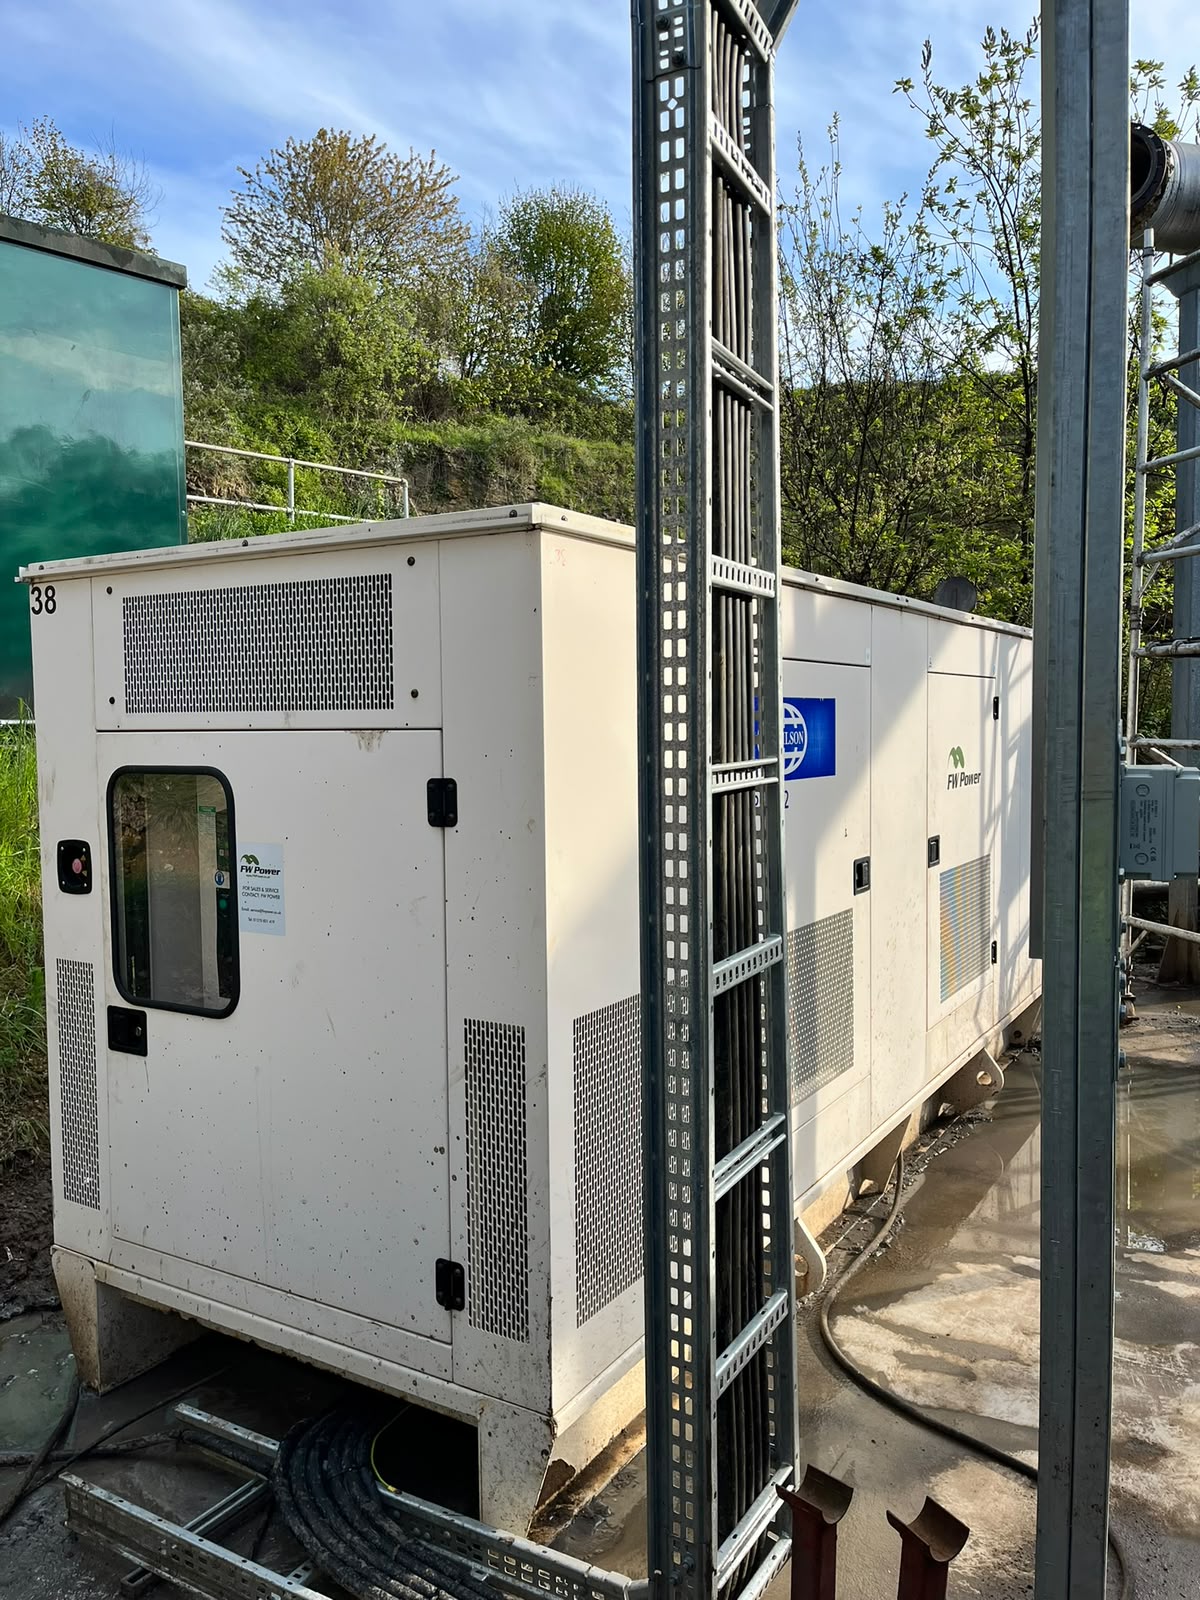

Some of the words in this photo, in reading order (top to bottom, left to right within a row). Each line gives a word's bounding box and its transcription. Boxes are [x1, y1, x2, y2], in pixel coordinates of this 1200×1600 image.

[31, 585, 57, 615] 38
[947, 773, 960, 790] FW
[960, 771, 981, 787] Power
[254, 867, 280, 875] Power
